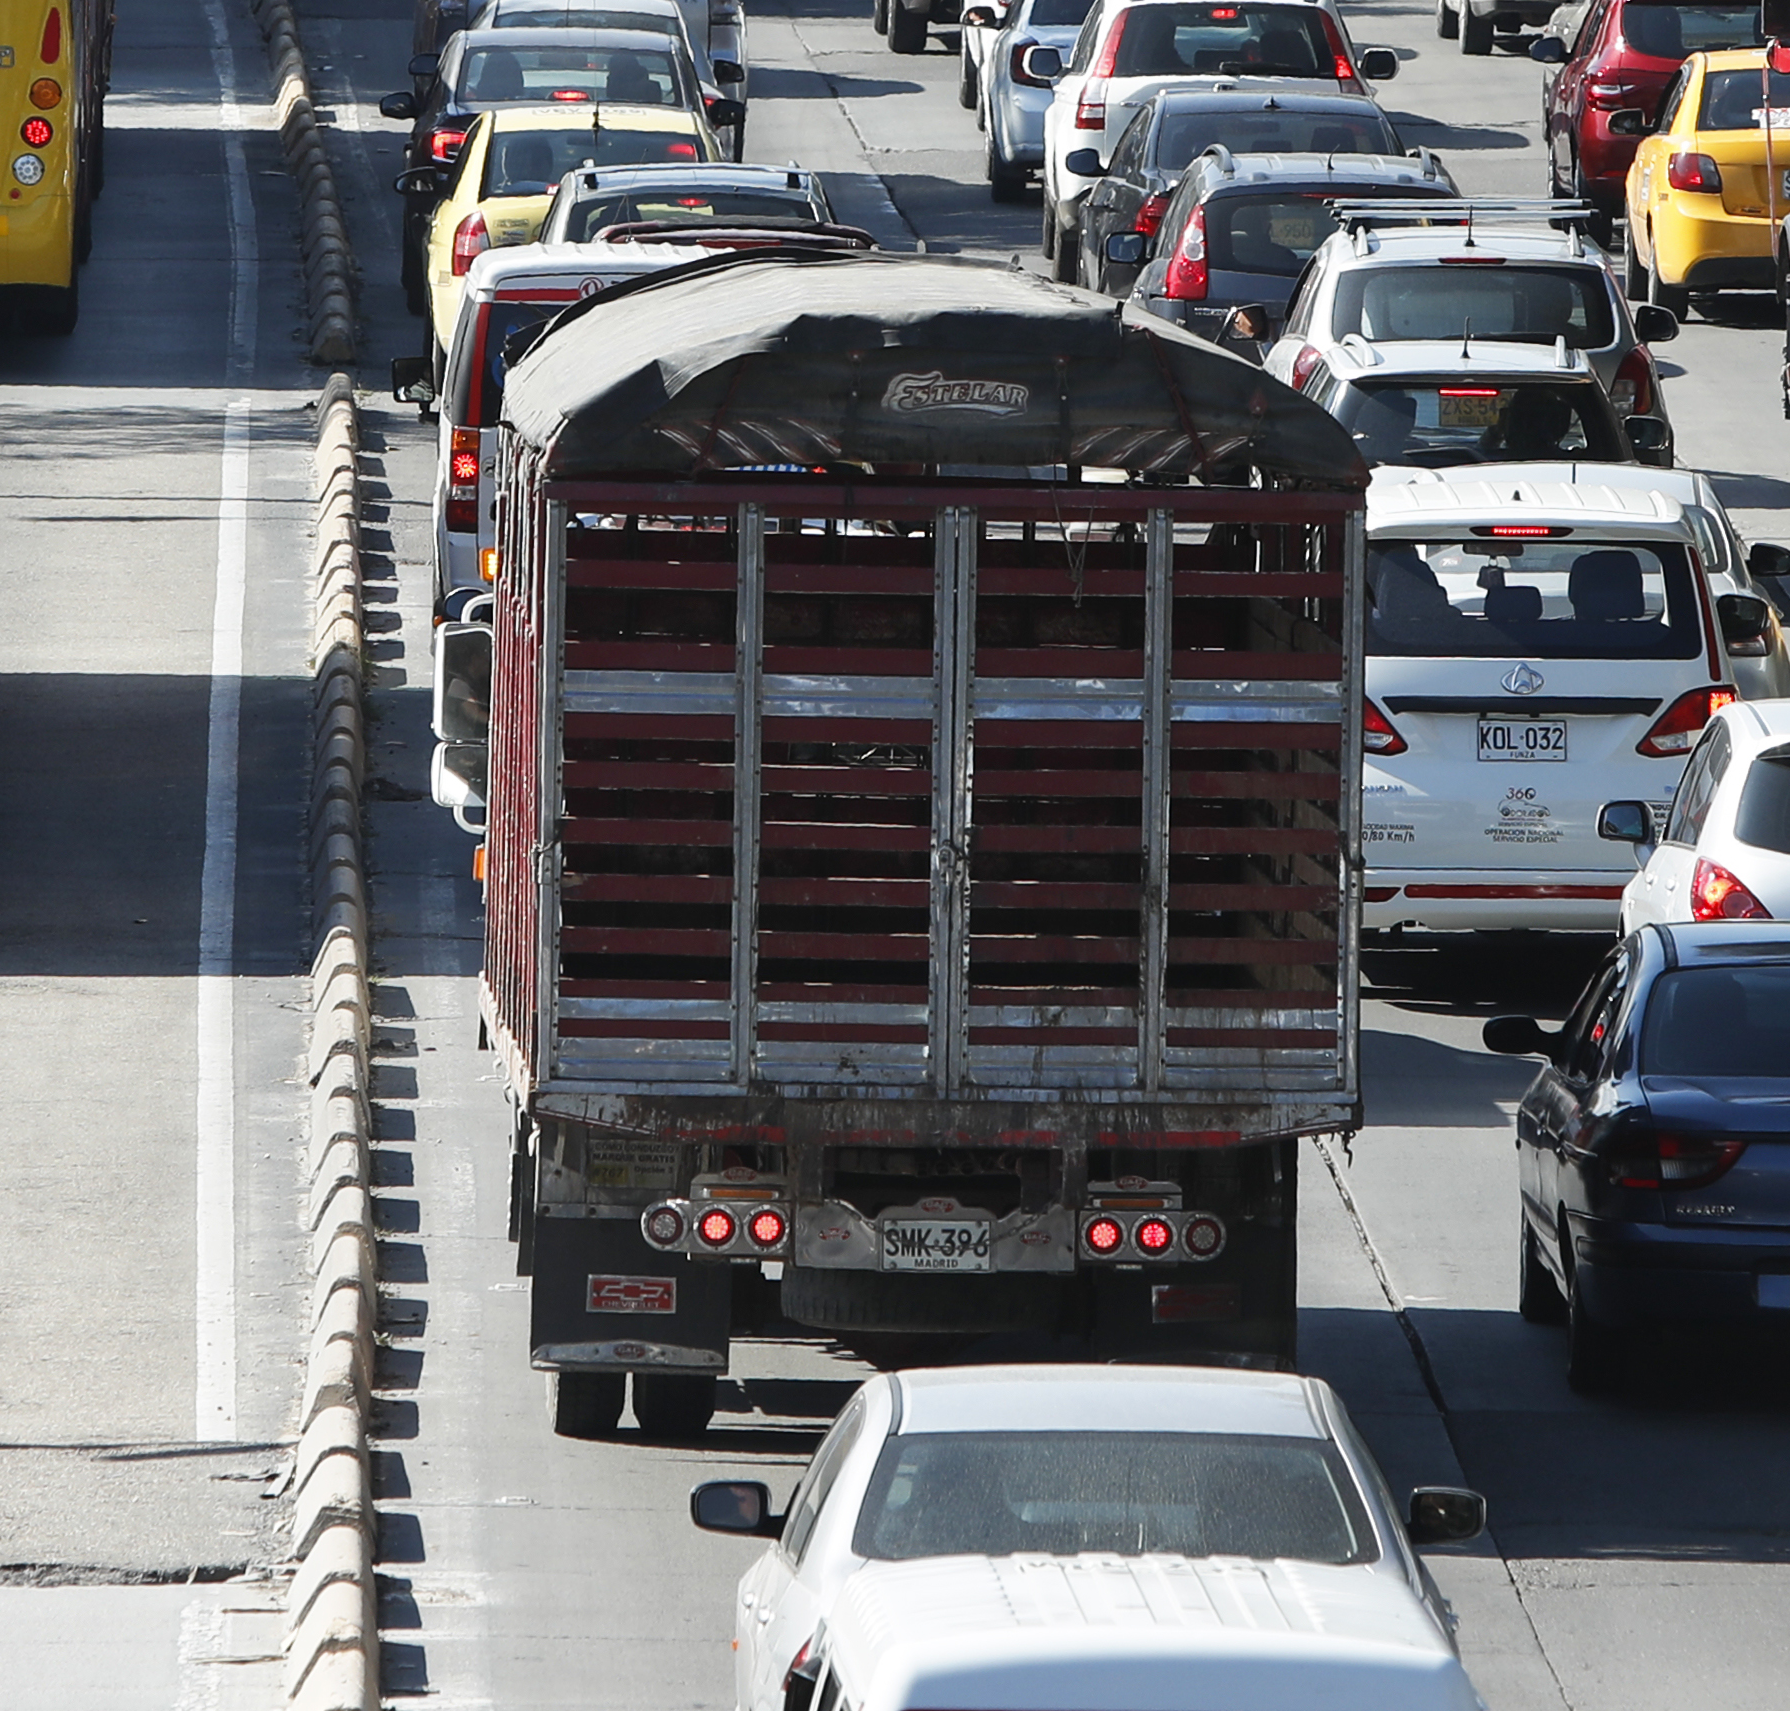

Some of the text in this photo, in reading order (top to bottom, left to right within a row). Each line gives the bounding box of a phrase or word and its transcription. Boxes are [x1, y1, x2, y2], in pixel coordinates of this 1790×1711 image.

[888, 372, 1027, 412] ESTELAR
[1509, 751, 1536, 759] FUNZA
[914, 1258, 958, 1268] MADRID
